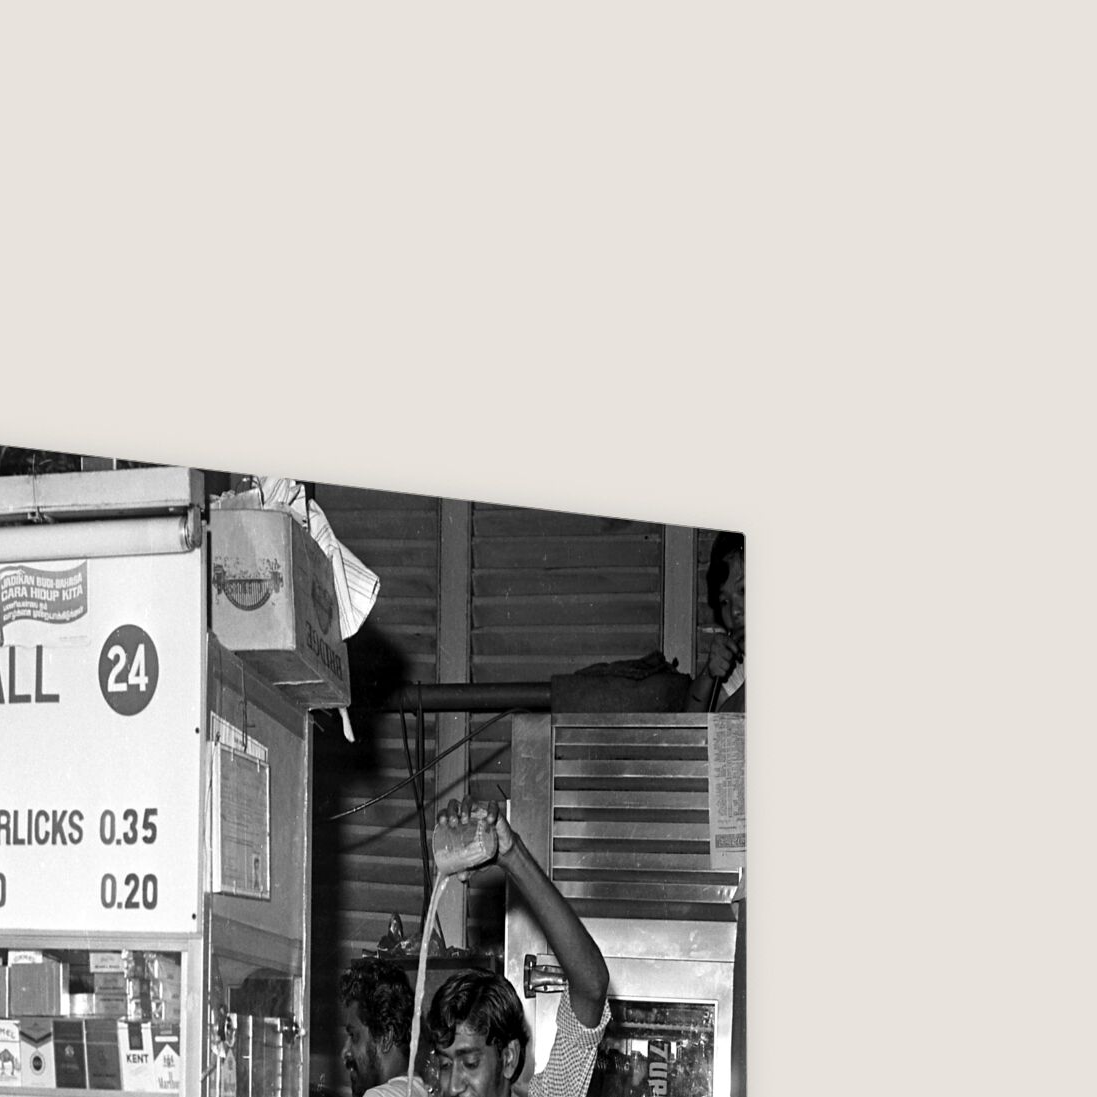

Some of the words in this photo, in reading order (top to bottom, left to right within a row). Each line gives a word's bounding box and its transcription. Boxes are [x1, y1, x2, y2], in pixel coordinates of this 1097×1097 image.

[1, 586, 28, 602] CARA
[30, 586, 59, 601] HIDUP
[62, 584, 83, 601] KITA
[106, 643, 149, 693] 24
[99, 808, 158, 845] 0.35
[100, 873, 158, 910] 0.20
[126, 1053, 149, 1064] KENT
